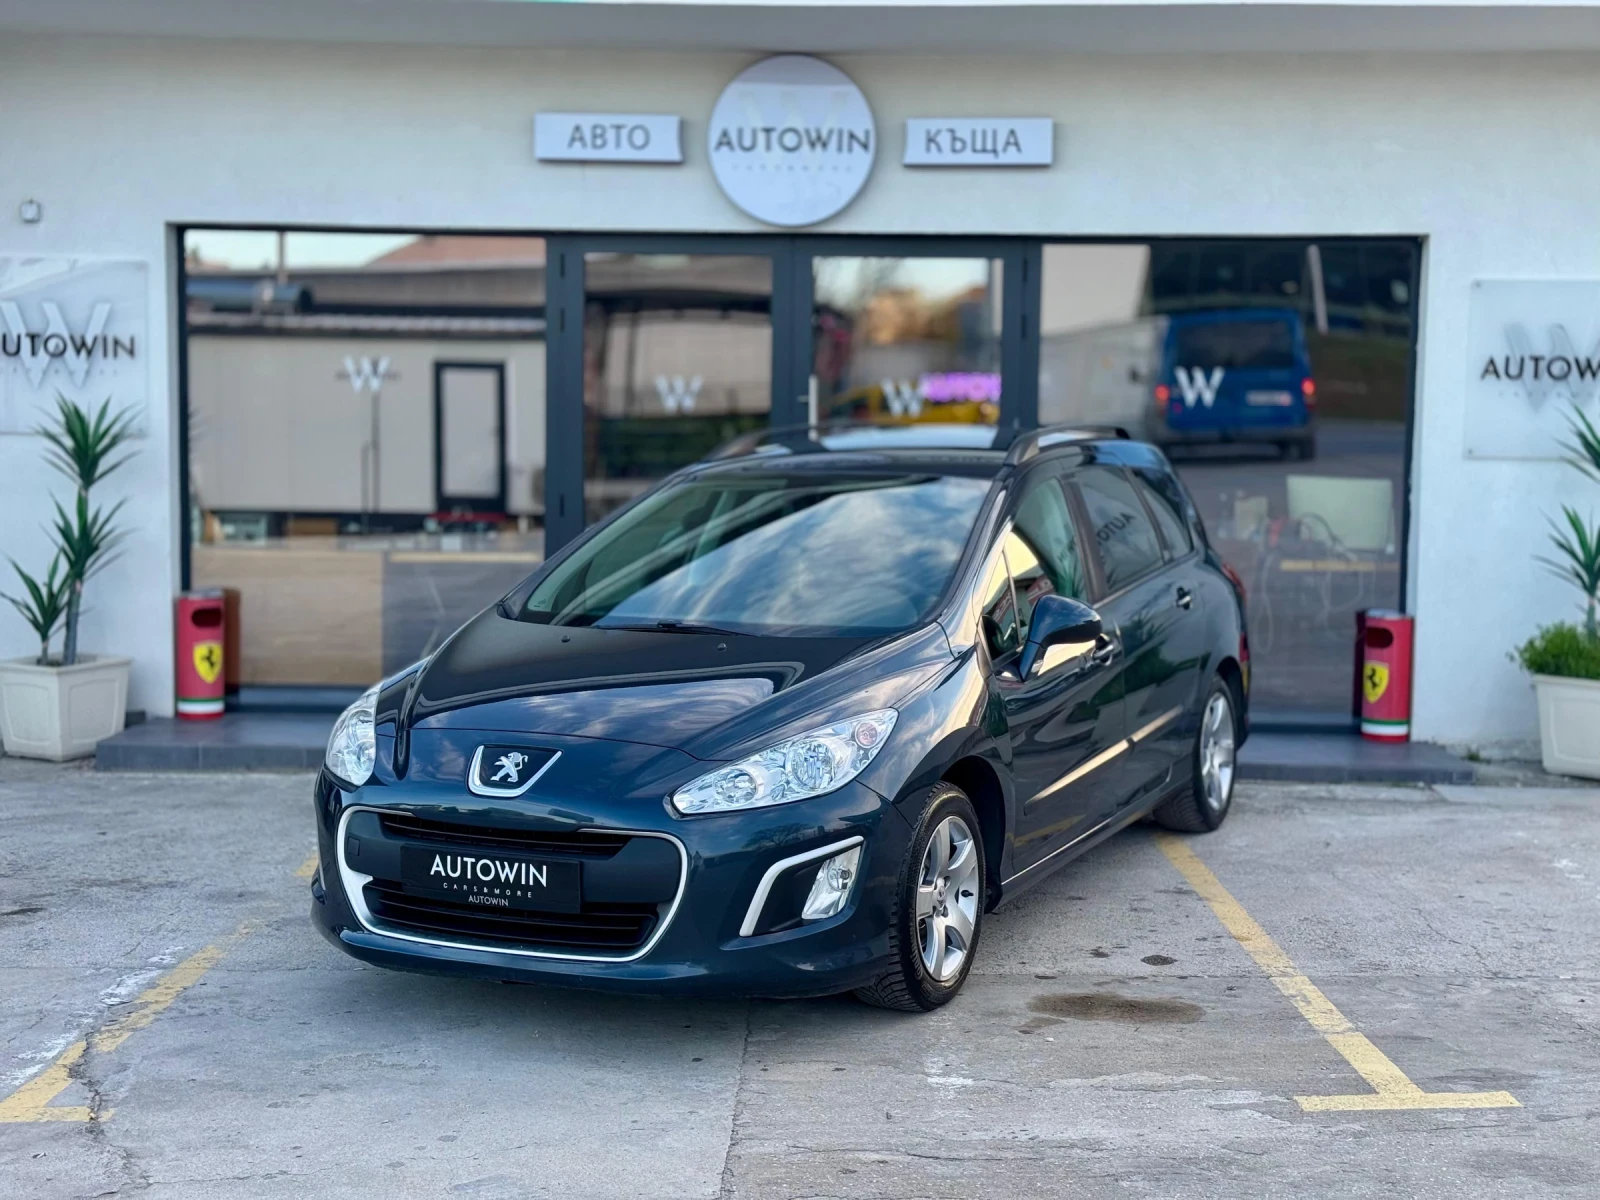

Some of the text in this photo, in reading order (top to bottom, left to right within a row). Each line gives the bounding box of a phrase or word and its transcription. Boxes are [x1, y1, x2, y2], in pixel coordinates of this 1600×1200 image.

[567, 123, 651, 151] АВТО
[714, 127, 871, 153] AUTOWIN
[924, 127, 1022, 160] КЪЩА
[2, 333, 136, 360] UTOWIN
[342, 355, 392, 393] W
[1480, 355, 1600, 381] AUTOW
[655, 374, 704, 413] W
[1174, 366, 1226, 409] W
[430, 854, 547, 887] AUTOWIN
[468, 895, 509, 907] AUTOWIN
